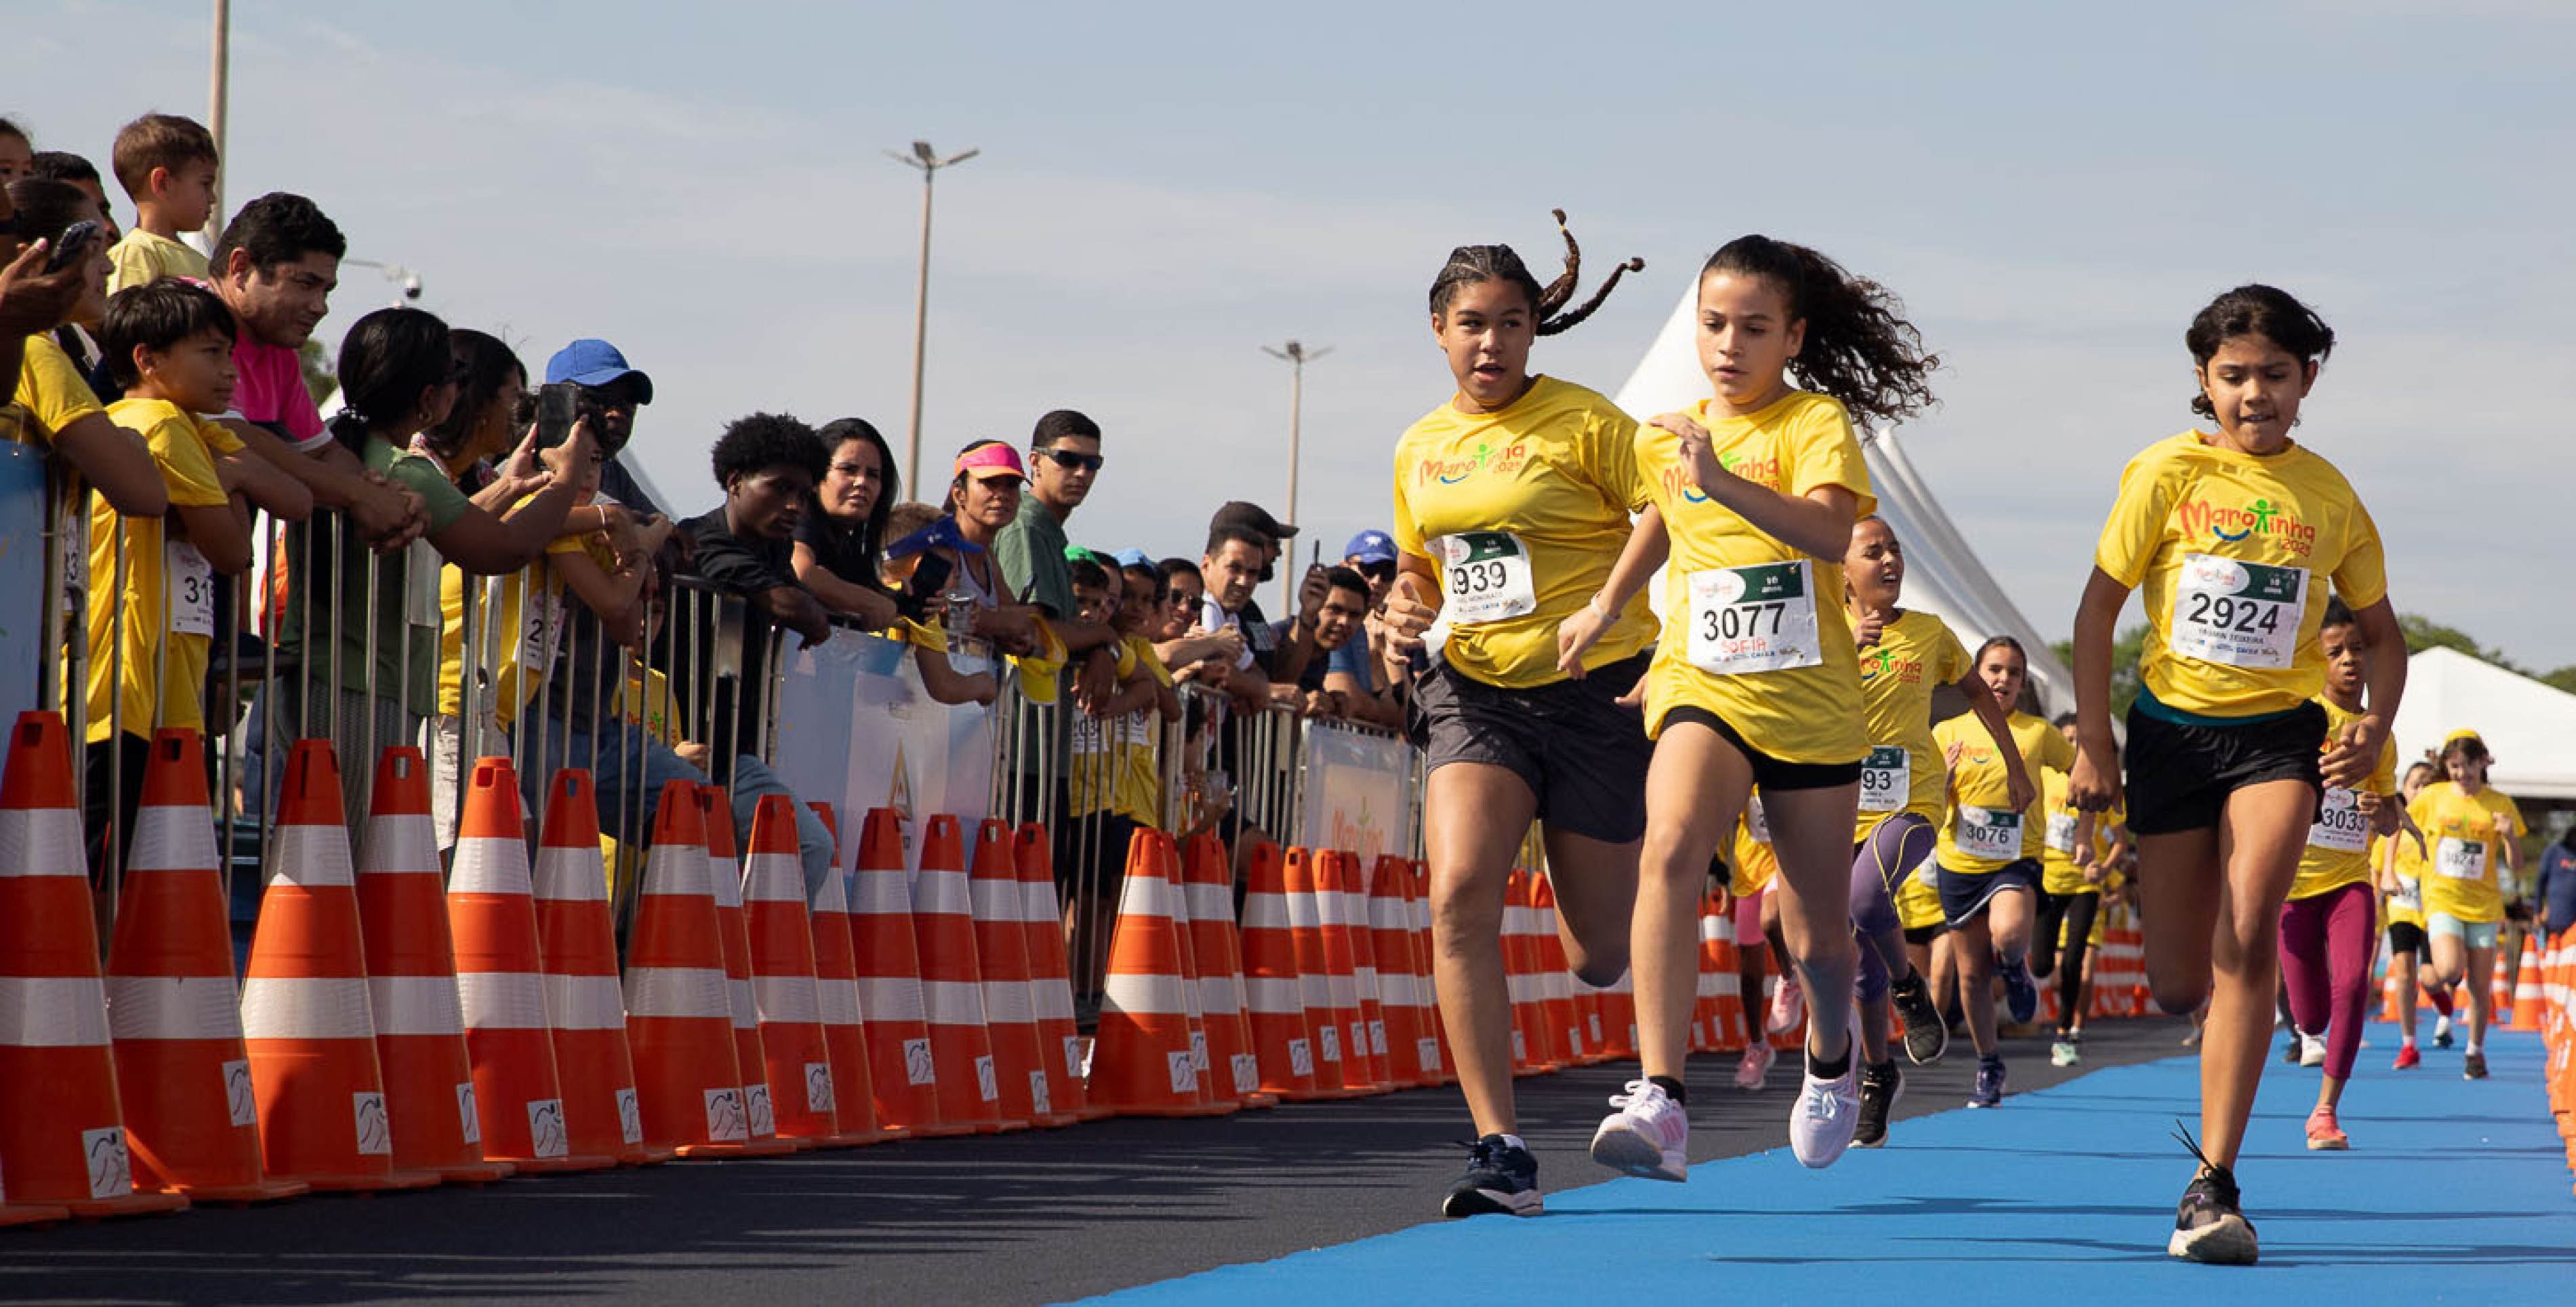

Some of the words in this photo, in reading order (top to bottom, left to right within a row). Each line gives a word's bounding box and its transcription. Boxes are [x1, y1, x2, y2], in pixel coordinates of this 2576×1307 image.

[1449, 561, 1507, 595] 939
[1703, 602, 1785, 641] 3077
[2188, 592, 2280, 635] 2924
[1862, 769, 1892, 790] 93
[1967, 824, 2009, 844] 3076
